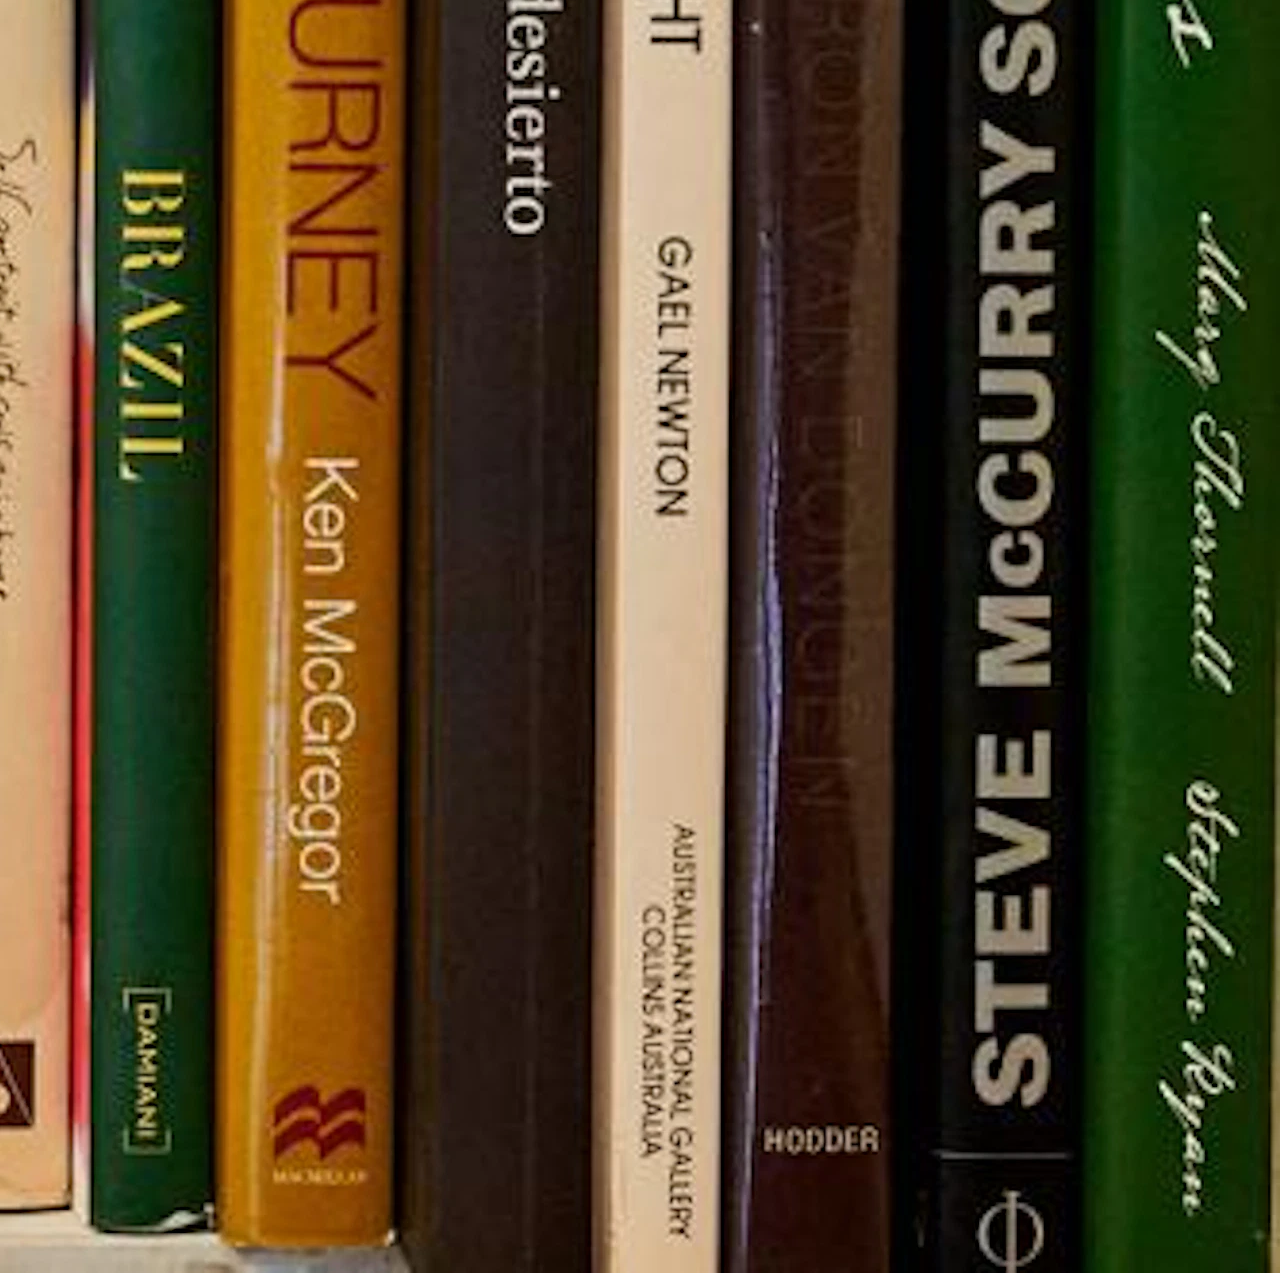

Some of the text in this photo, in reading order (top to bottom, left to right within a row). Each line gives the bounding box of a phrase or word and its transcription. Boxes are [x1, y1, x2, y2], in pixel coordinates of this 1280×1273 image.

[119, 168, 186, 483] BRAZIL
[655, 235, 693, 517] GAEL NEWTON
[975, 119, 1058, 689] McCURRY
[286, 458, 361, 904] Ken McGregor
[1188, 411, 1246, 695] Thornell
[640, 905, 666, 1159] COLLINS AUSTRALIA
[667, 822, 696, 1241] AUSTRALIAN NATIONAL GALLERY
[970, 727, 1053, 1109] STEVE
[1158, 779, 1241, 1218] Stephen Ryan
[762, 1125, 881, 1154] HODDER
